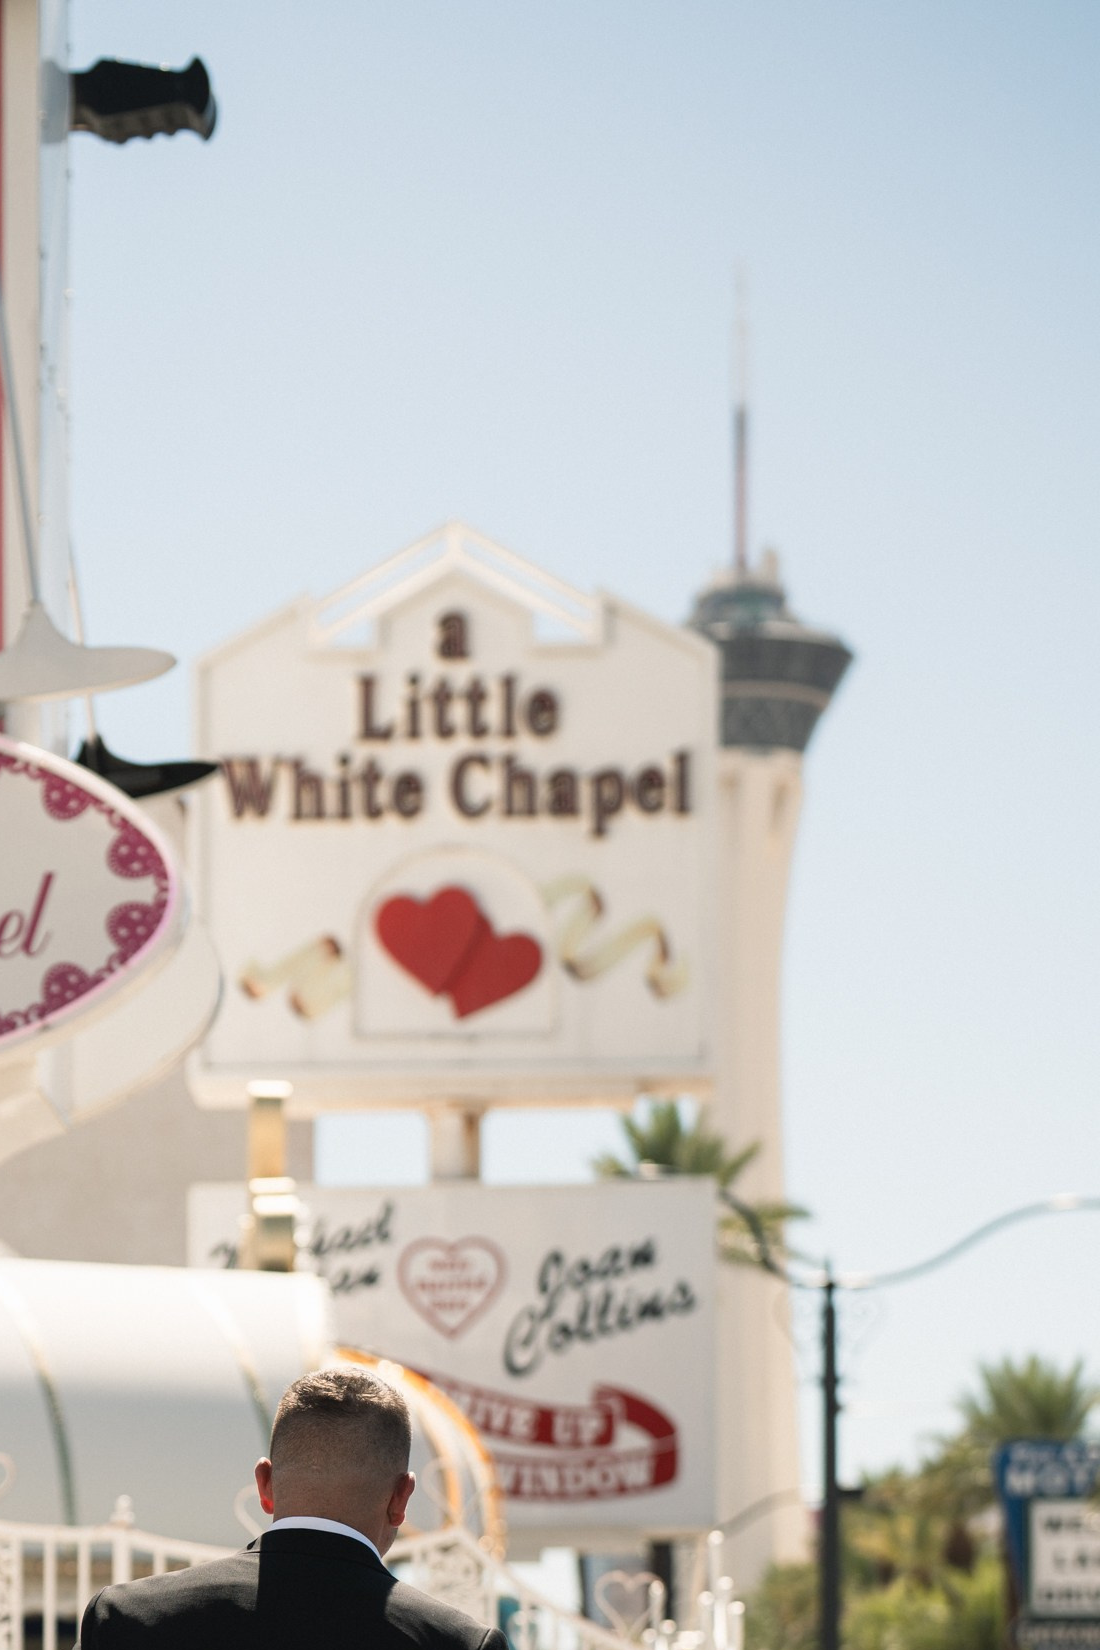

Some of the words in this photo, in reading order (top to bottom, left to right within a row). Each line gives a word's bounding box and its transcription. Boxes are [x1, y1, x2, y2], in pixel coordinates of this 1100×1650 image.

[436, 608, 468, 661] a
[355, 672, 560, 743] Little
[219, 752, 426, 823] White
[448, 750, 694, 839] Chapel
[536, 1234, 656, 1325] Joan
[502, 1278, 697, 1380] Collins
[553, 1409, 606, 1446] UP
